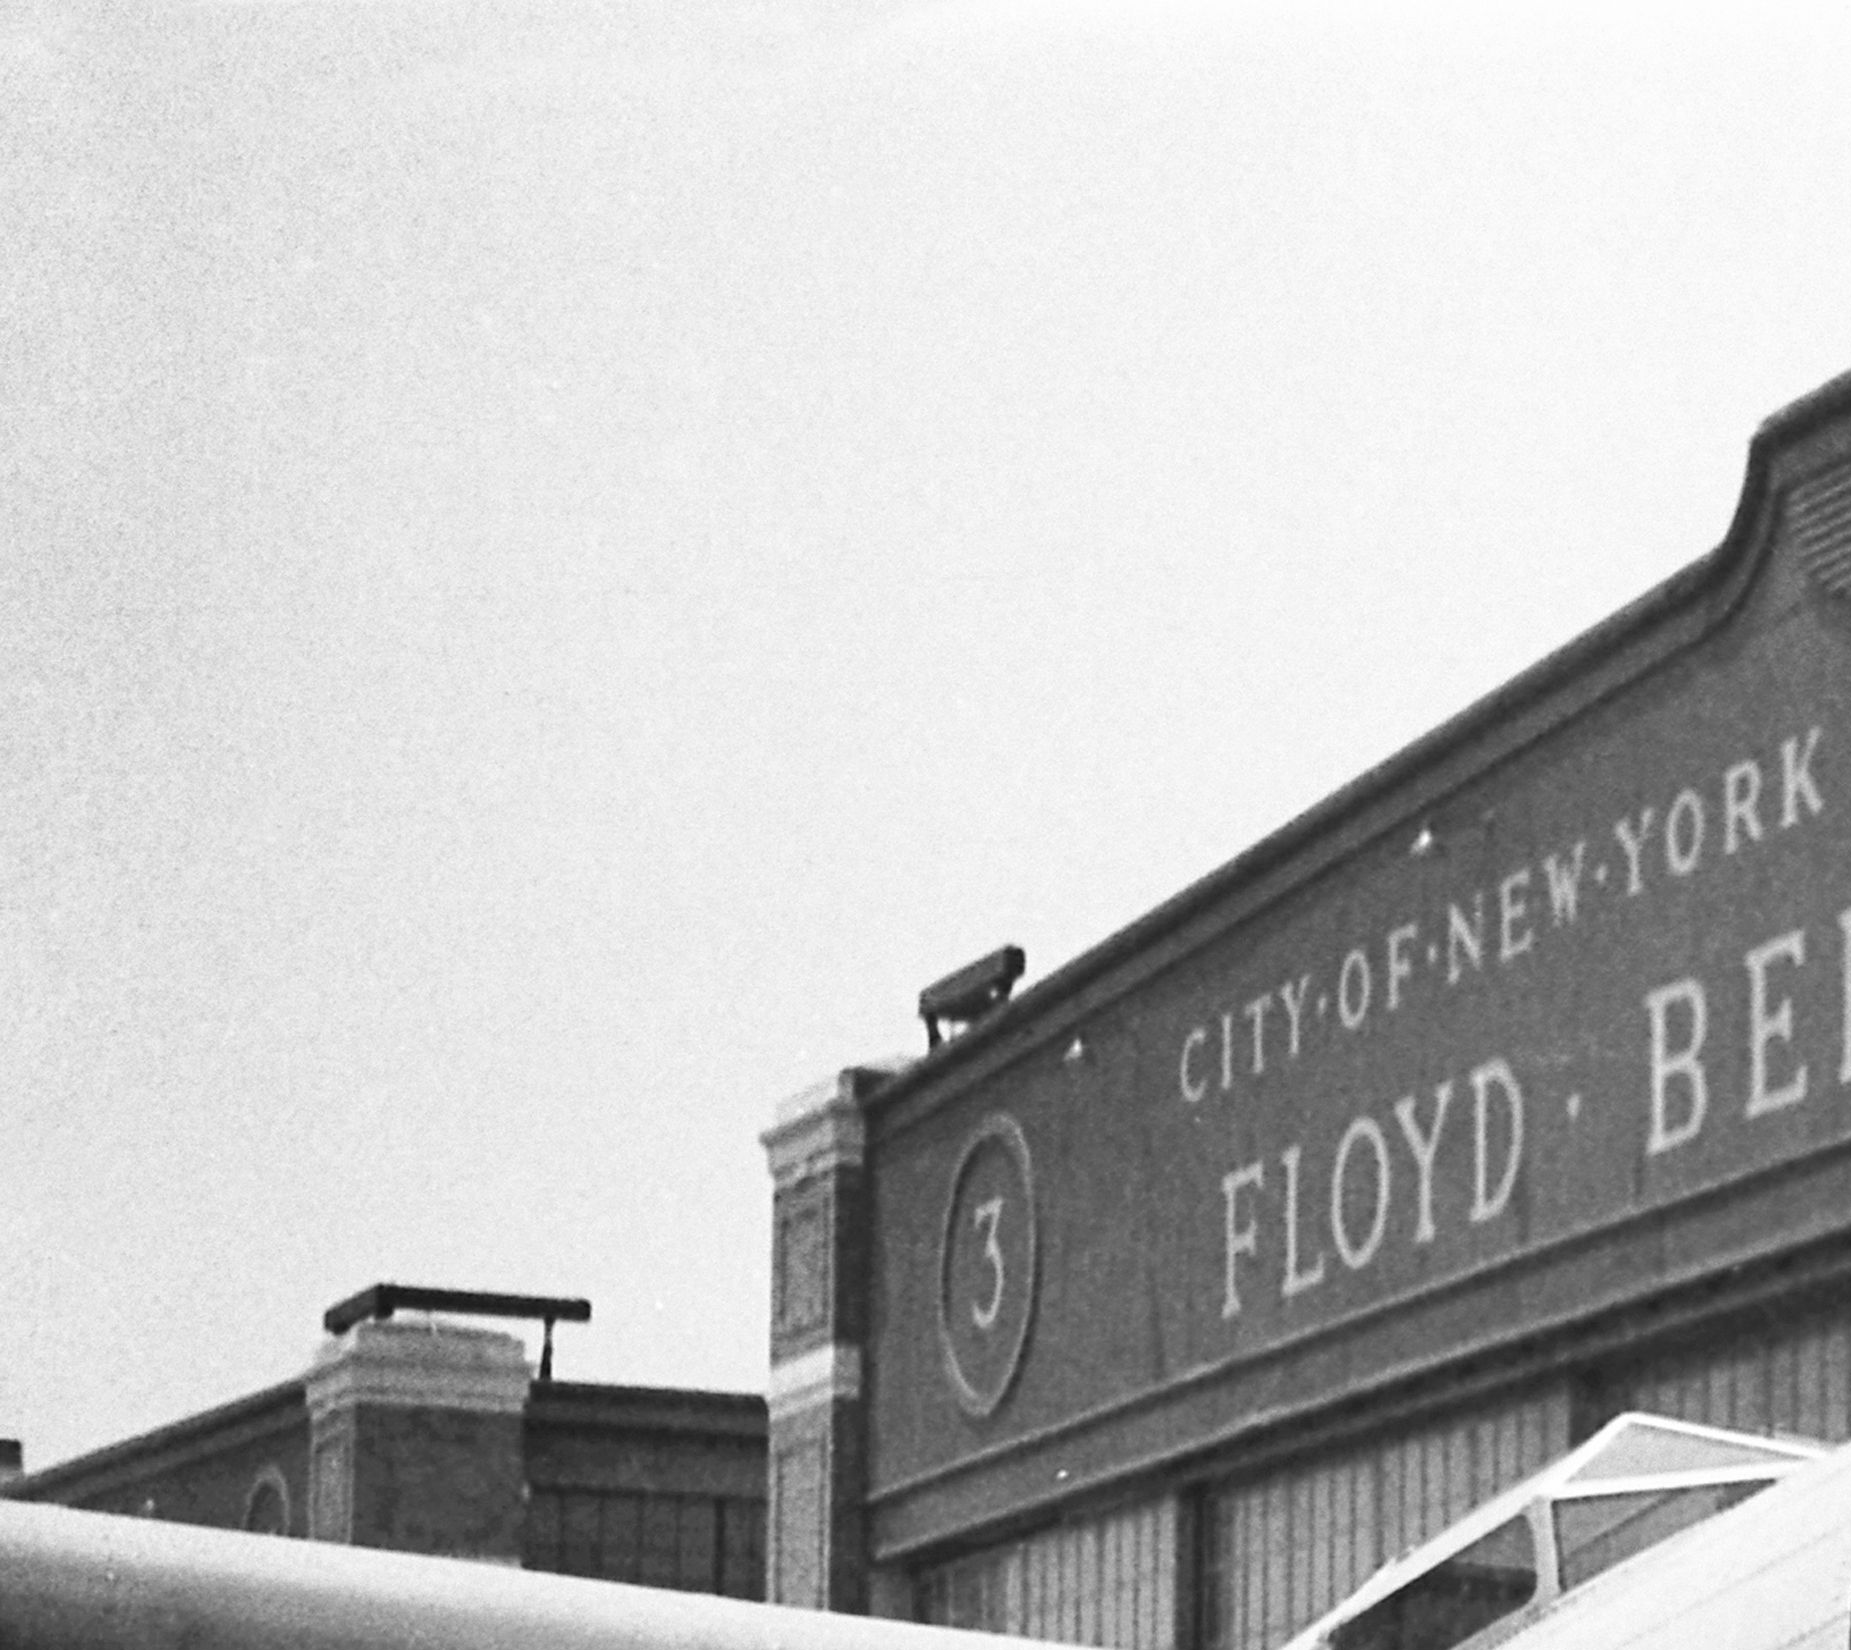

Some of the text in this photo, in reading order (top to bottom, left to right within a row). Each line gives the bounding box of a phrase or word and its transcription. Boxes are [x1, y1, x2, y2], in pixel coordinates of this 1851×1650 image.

[1180, 726, 1825, 1101] CITY OF NEW YORK
[973, 1196, 1004, 1329] 3
[1220, 1058, 1524, 1319] FLOYD
